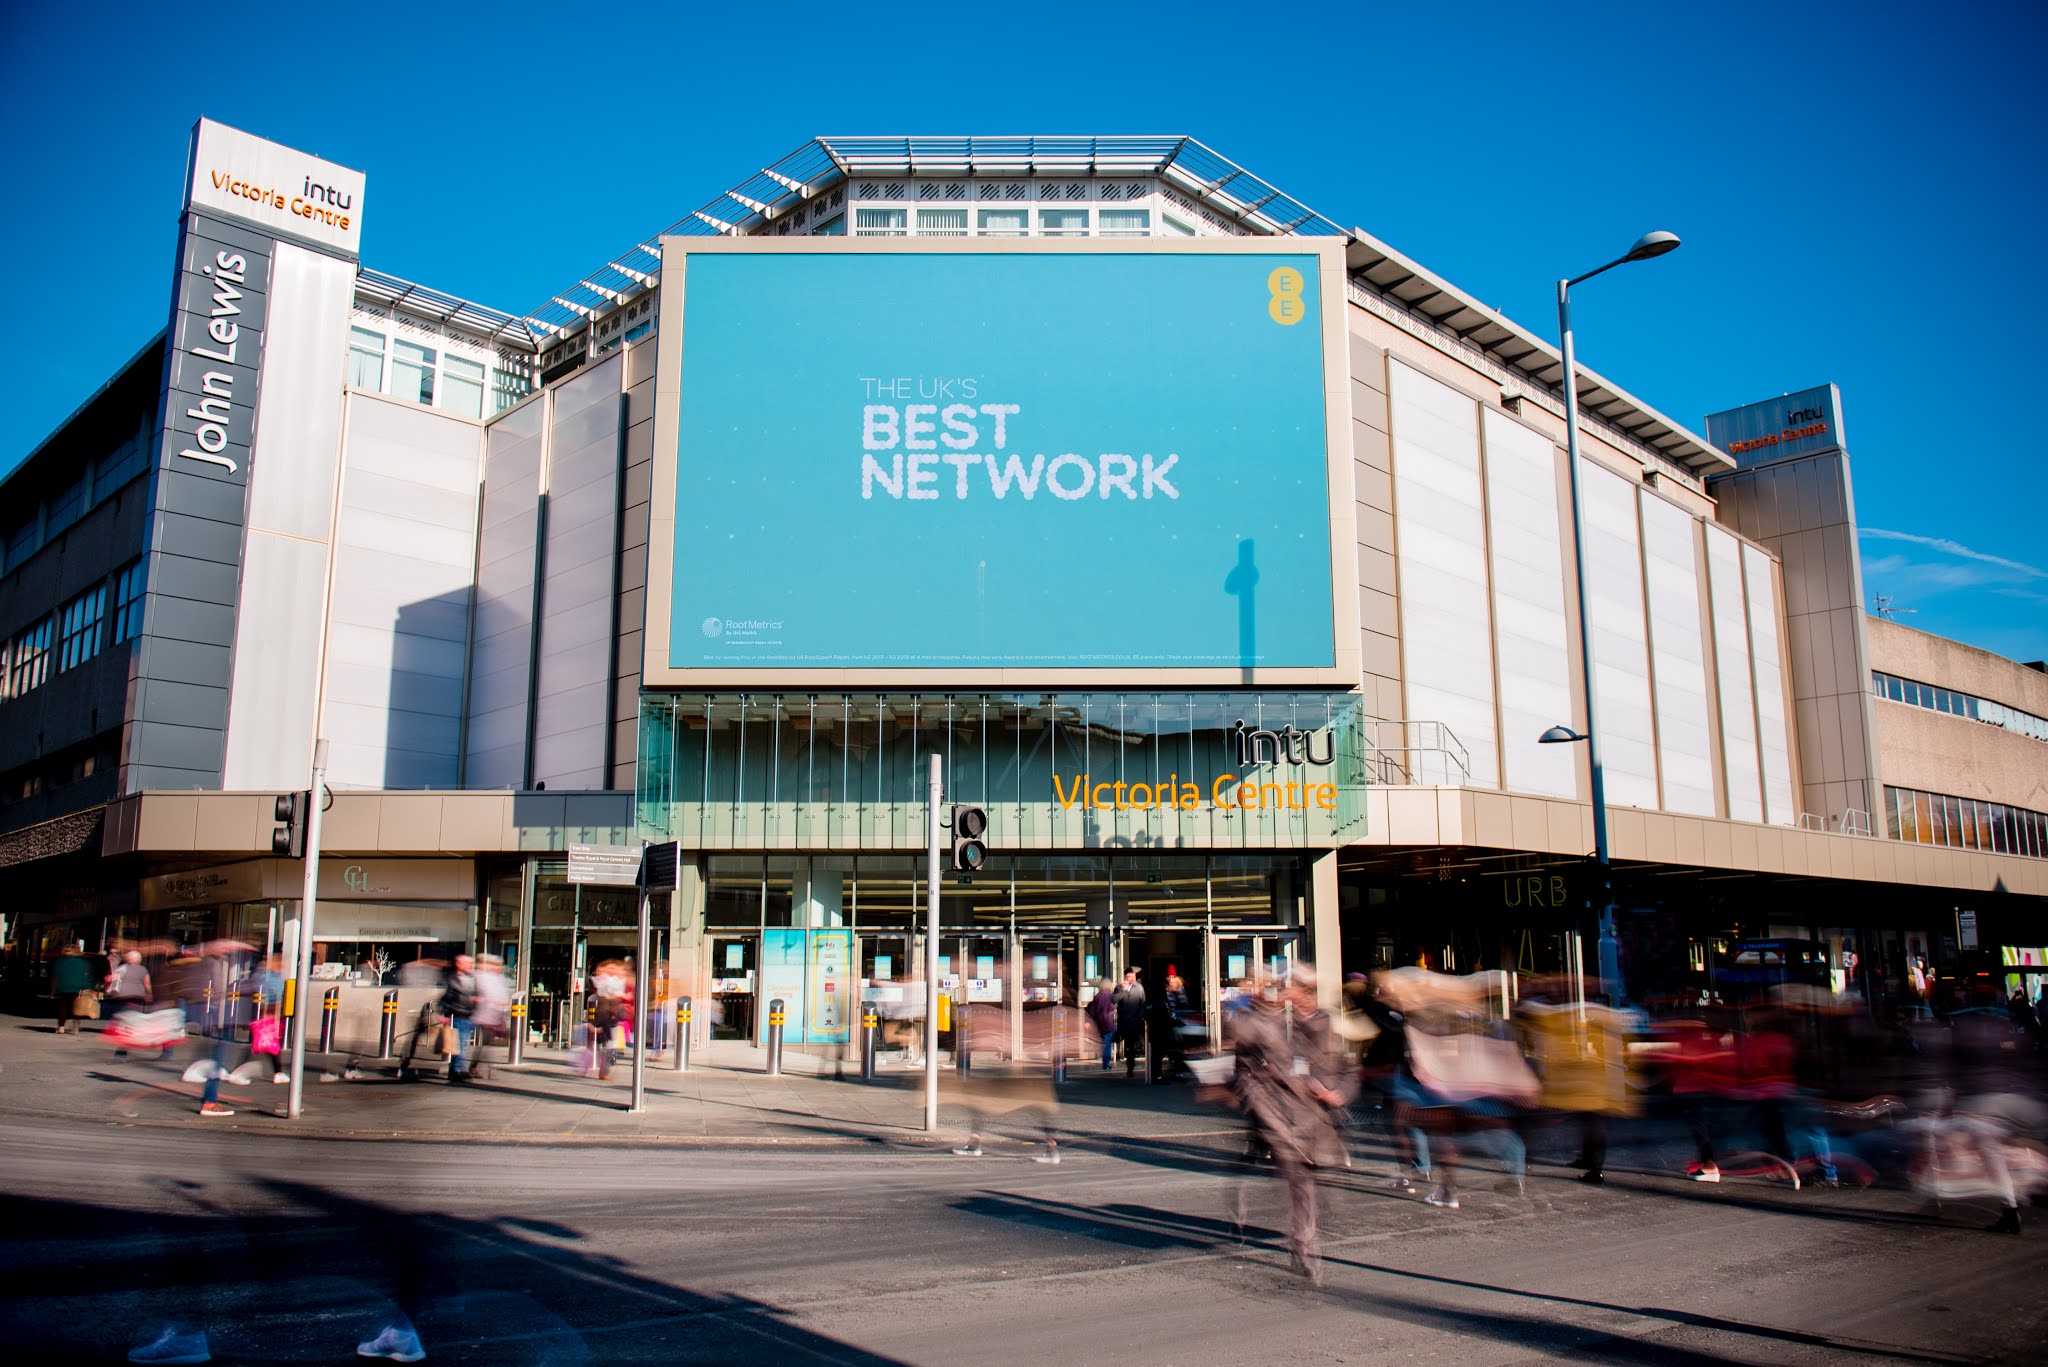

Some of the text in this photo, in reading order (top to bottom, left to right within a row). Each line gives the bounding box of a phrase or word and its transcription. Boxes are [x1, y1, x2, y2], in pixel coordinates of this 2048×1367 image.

[211, 169, 351, 231] Victoria Centre
[303, 176, 352, 210] intu
[178, 250, 247, 475] John Lewis
[861, 378, 977, 399] THE UK'S
[862, 403, 1021, 450] BEST
[1788, 405, 1824, 426] intu
[1728, 422, 1828, 455] Victoria Centre
[862, 453, 1180, 500] NETWORK
[1234, 718, 1336, 768] intu
[1053, 773, 1338, 810] Victoria Centre
